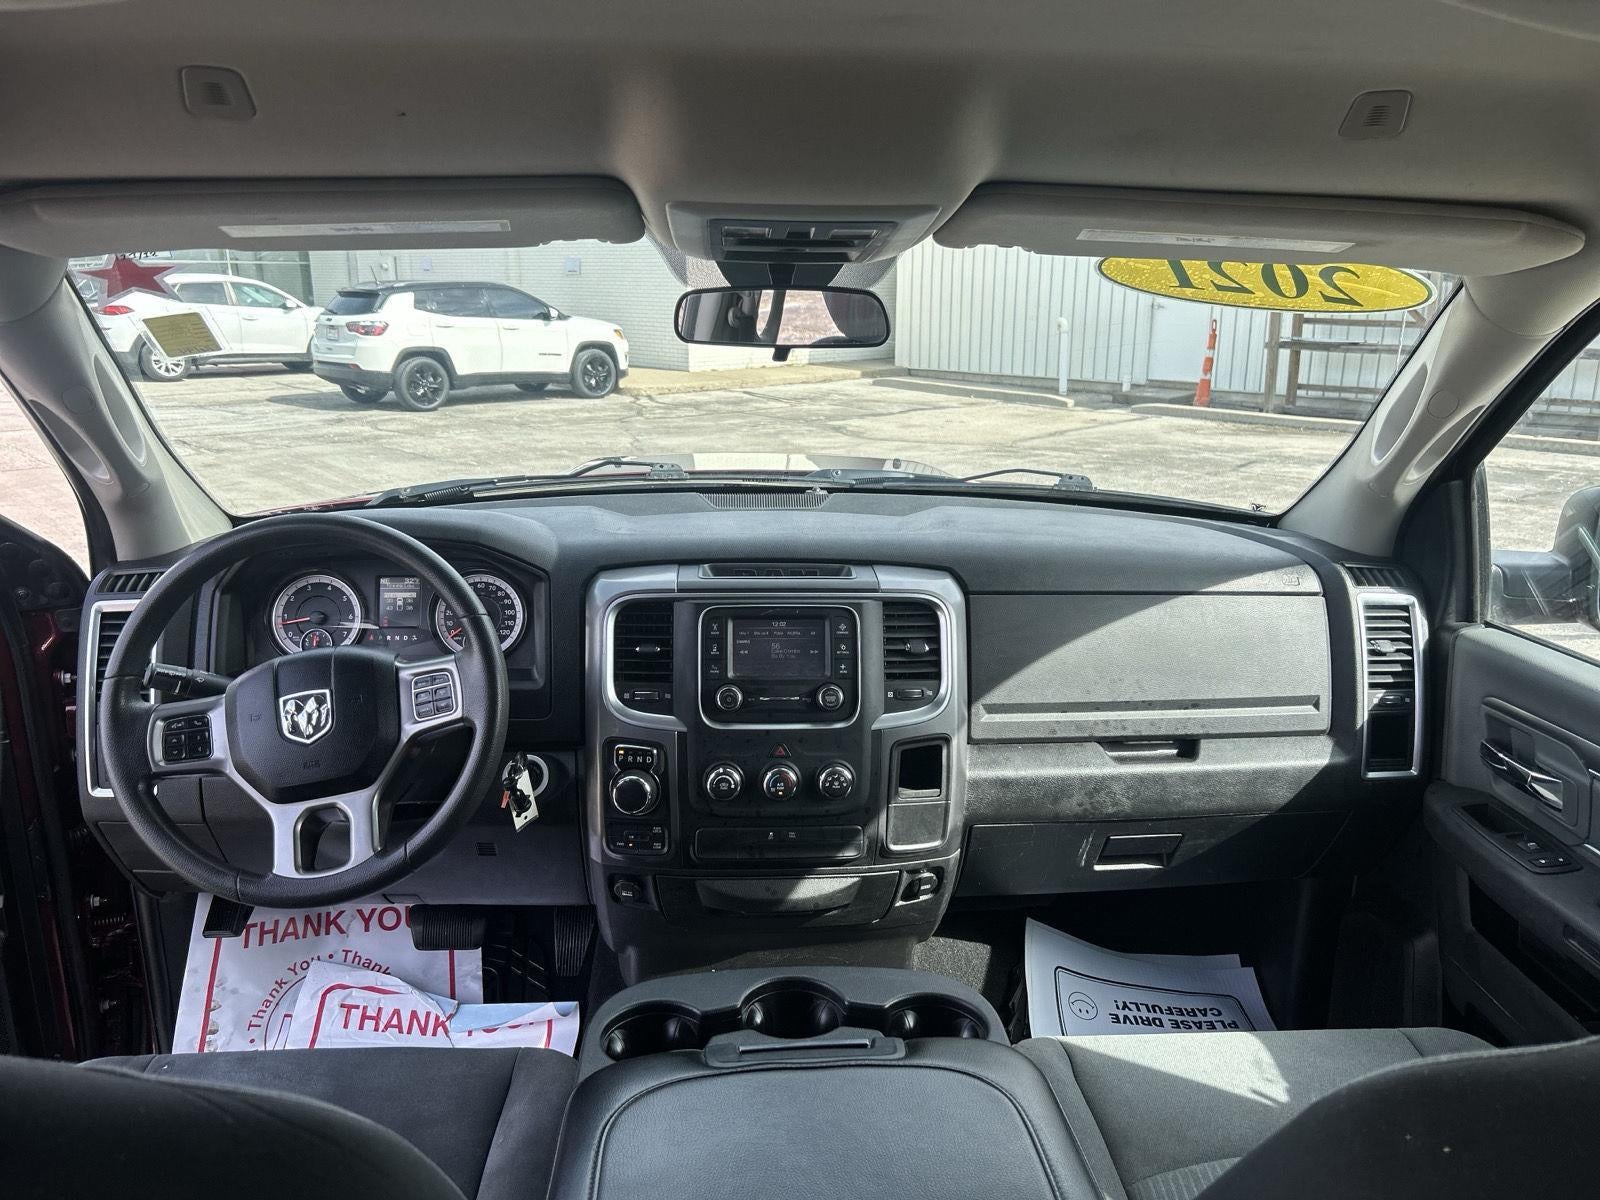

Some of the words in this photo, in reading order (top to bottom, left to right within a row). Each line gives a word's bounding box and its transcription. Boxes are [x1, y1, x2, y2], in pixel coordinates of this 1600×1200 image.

[243, 910, 347, 948] THANK
[247, 977, 289, 1031] Thank
[1113, 999, 1223, 1018] CAREFULLY!
[340, 1003, 453, 1037] THANK
[1108, 1012, 1165, 1028] DRIVE
[1168, 1018, 1240, 1031] PLEASE
